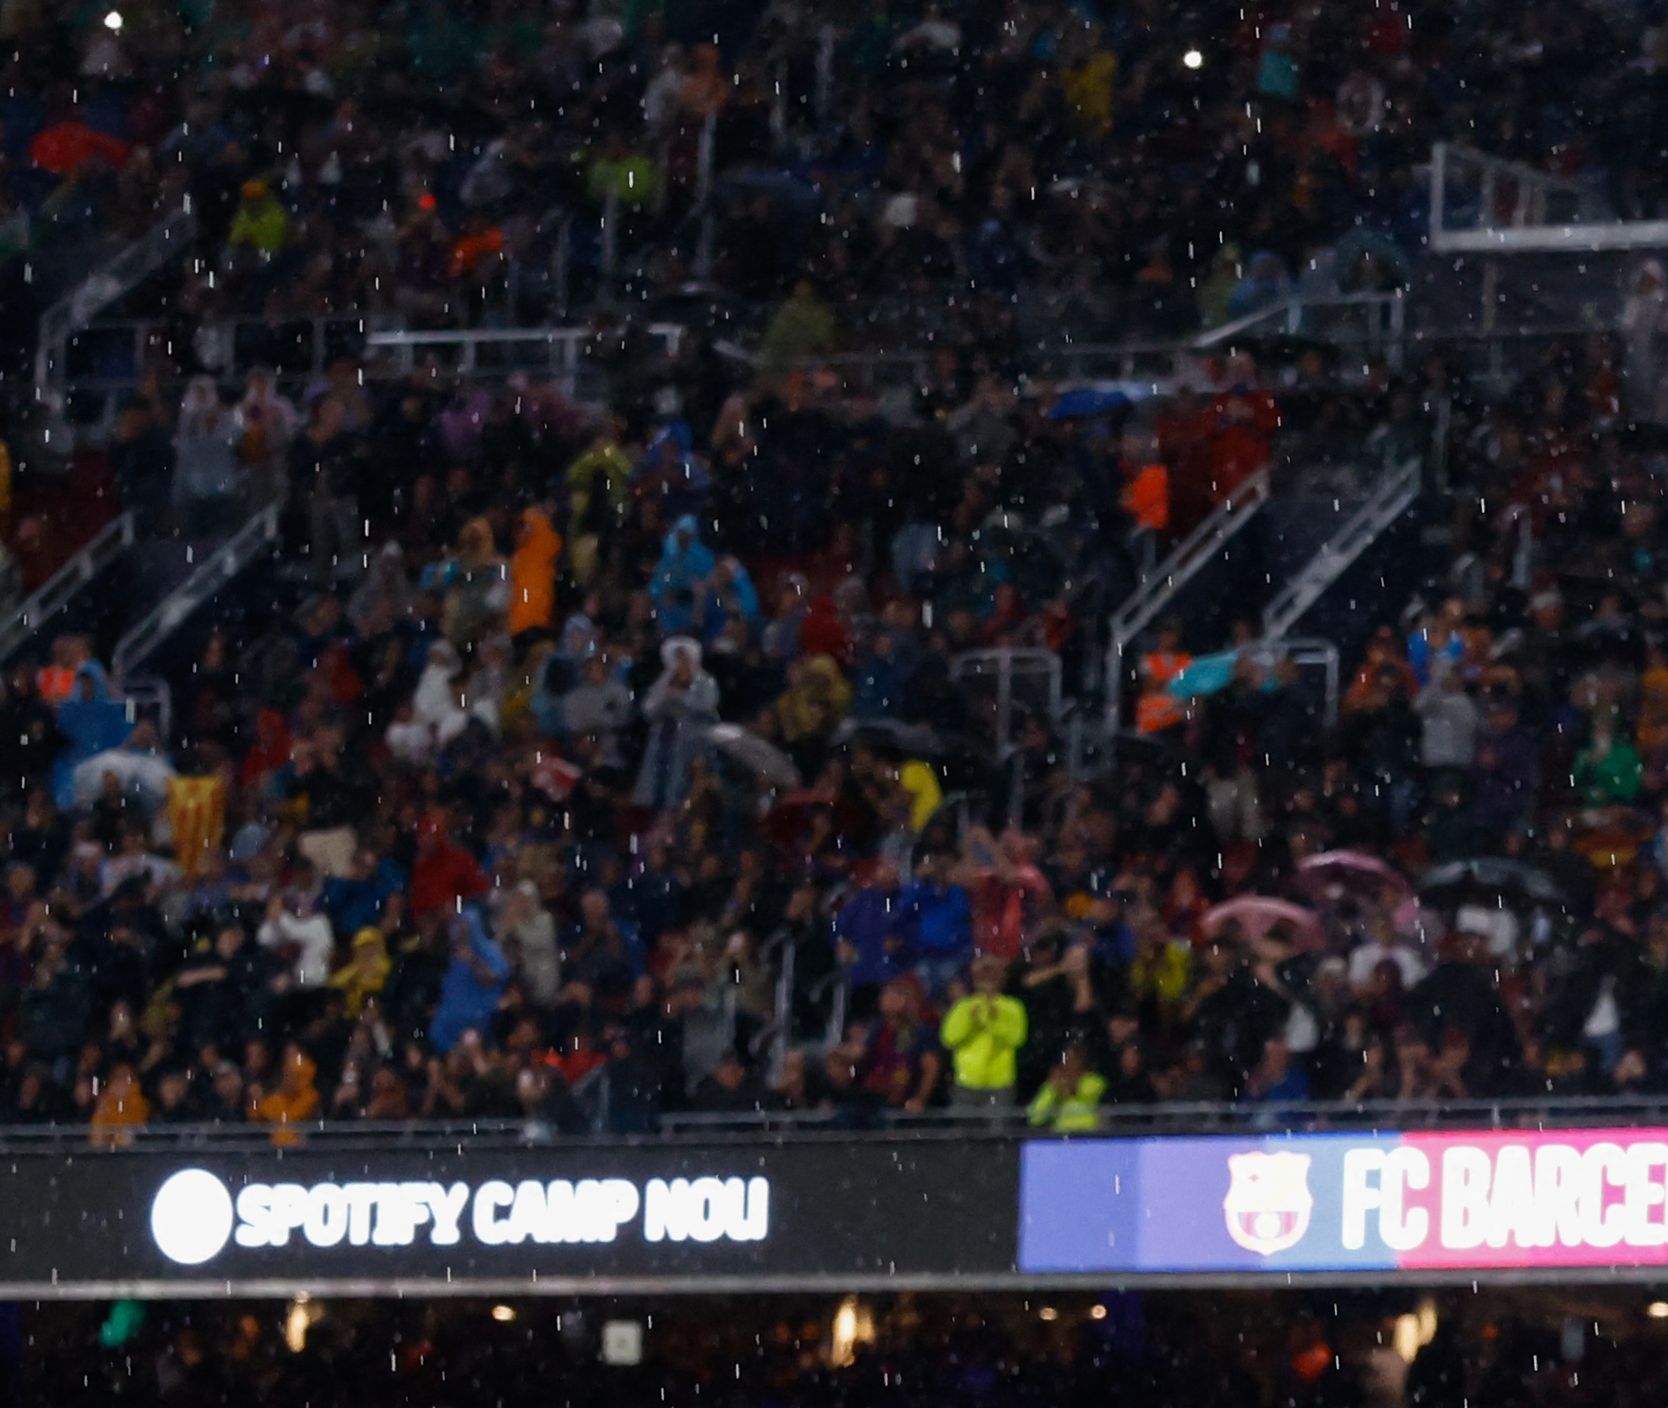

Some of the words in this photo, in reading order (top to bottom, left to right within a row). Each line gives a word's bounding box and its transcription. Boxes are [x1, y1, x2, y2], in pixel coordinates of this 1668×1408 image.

[235, 1179, 469, 1249] SPOTIFY
[472, 1175, 640, 1246] CAMP
[643, 1174, 769, 1243] NOU
[1341, 1146, 1429, 1251] FC
